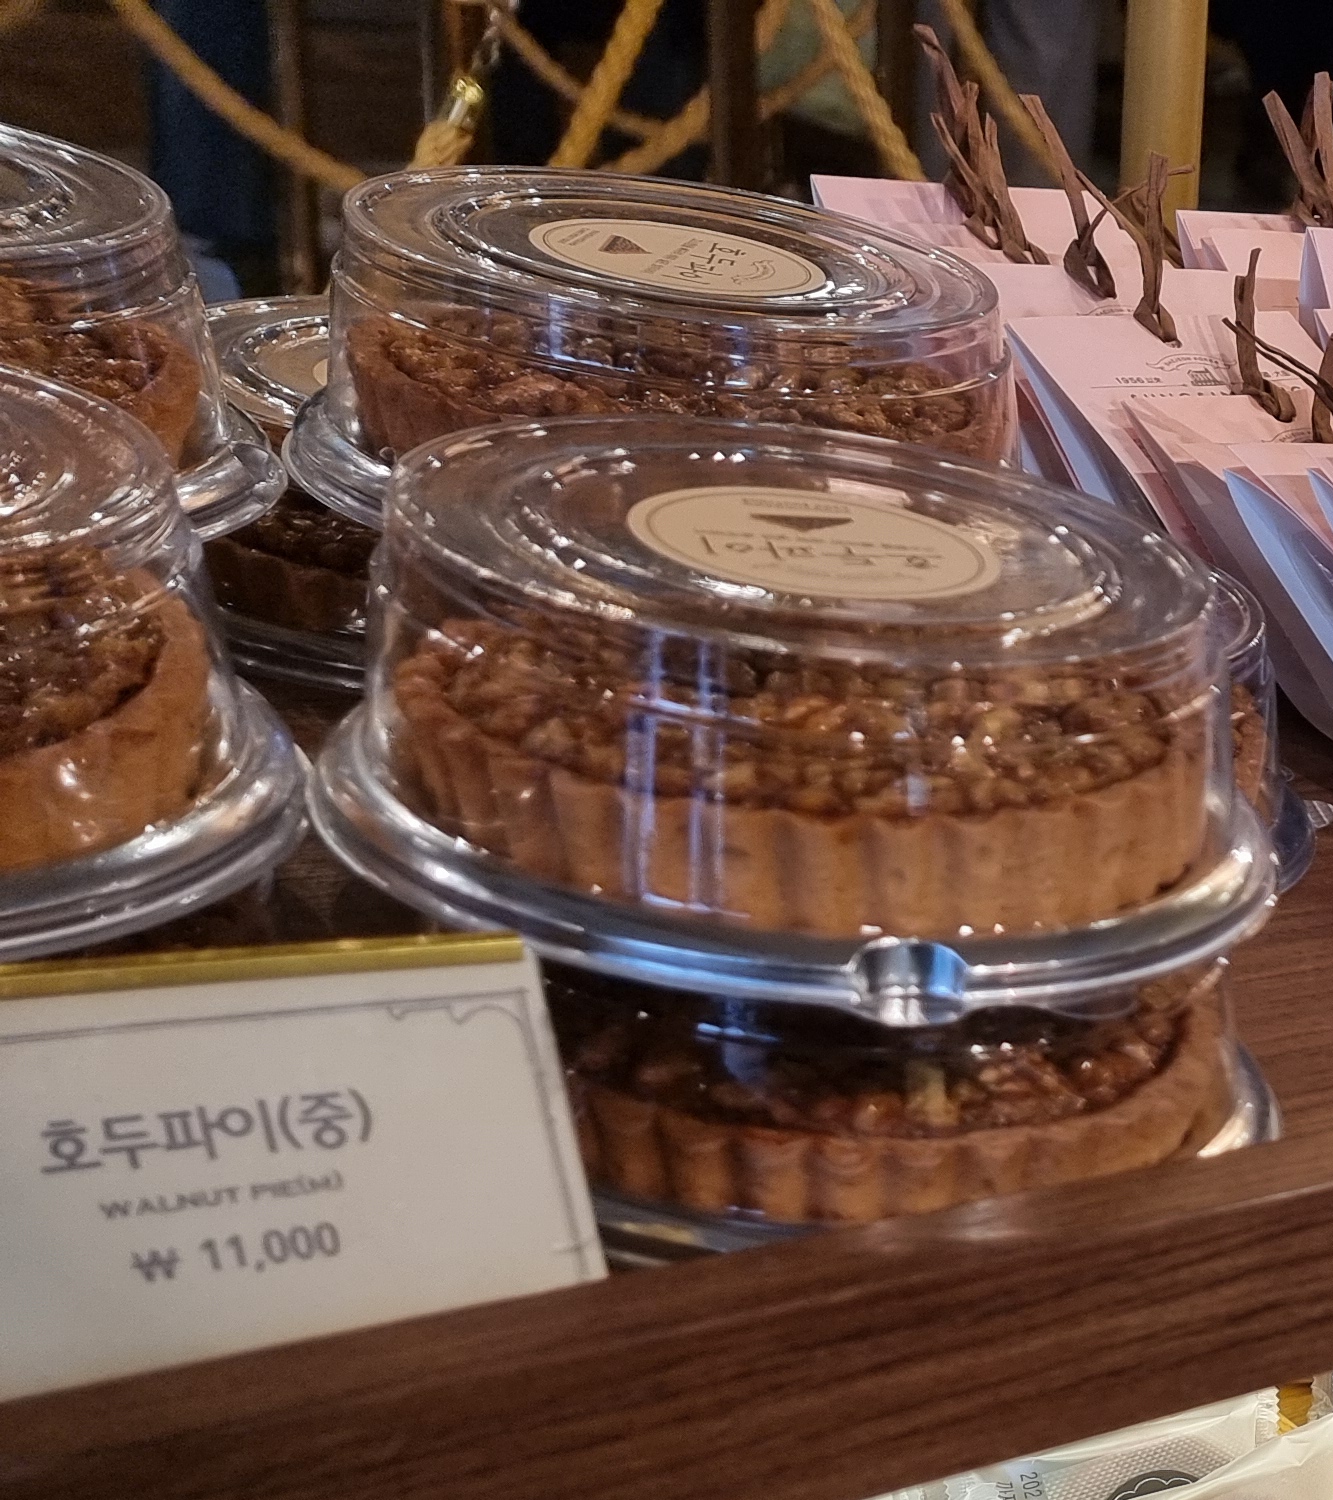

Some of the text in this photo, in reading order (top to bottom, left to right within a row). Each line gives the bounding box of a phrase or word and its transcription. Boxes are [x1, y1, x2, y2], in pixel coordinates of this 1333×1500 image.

[40, 1087, 374, 1175] 호두파이(중)
[100, 1187, 240, 1221] WALNUT
[131, 1222, 342, 1283] ₩ 11,000
